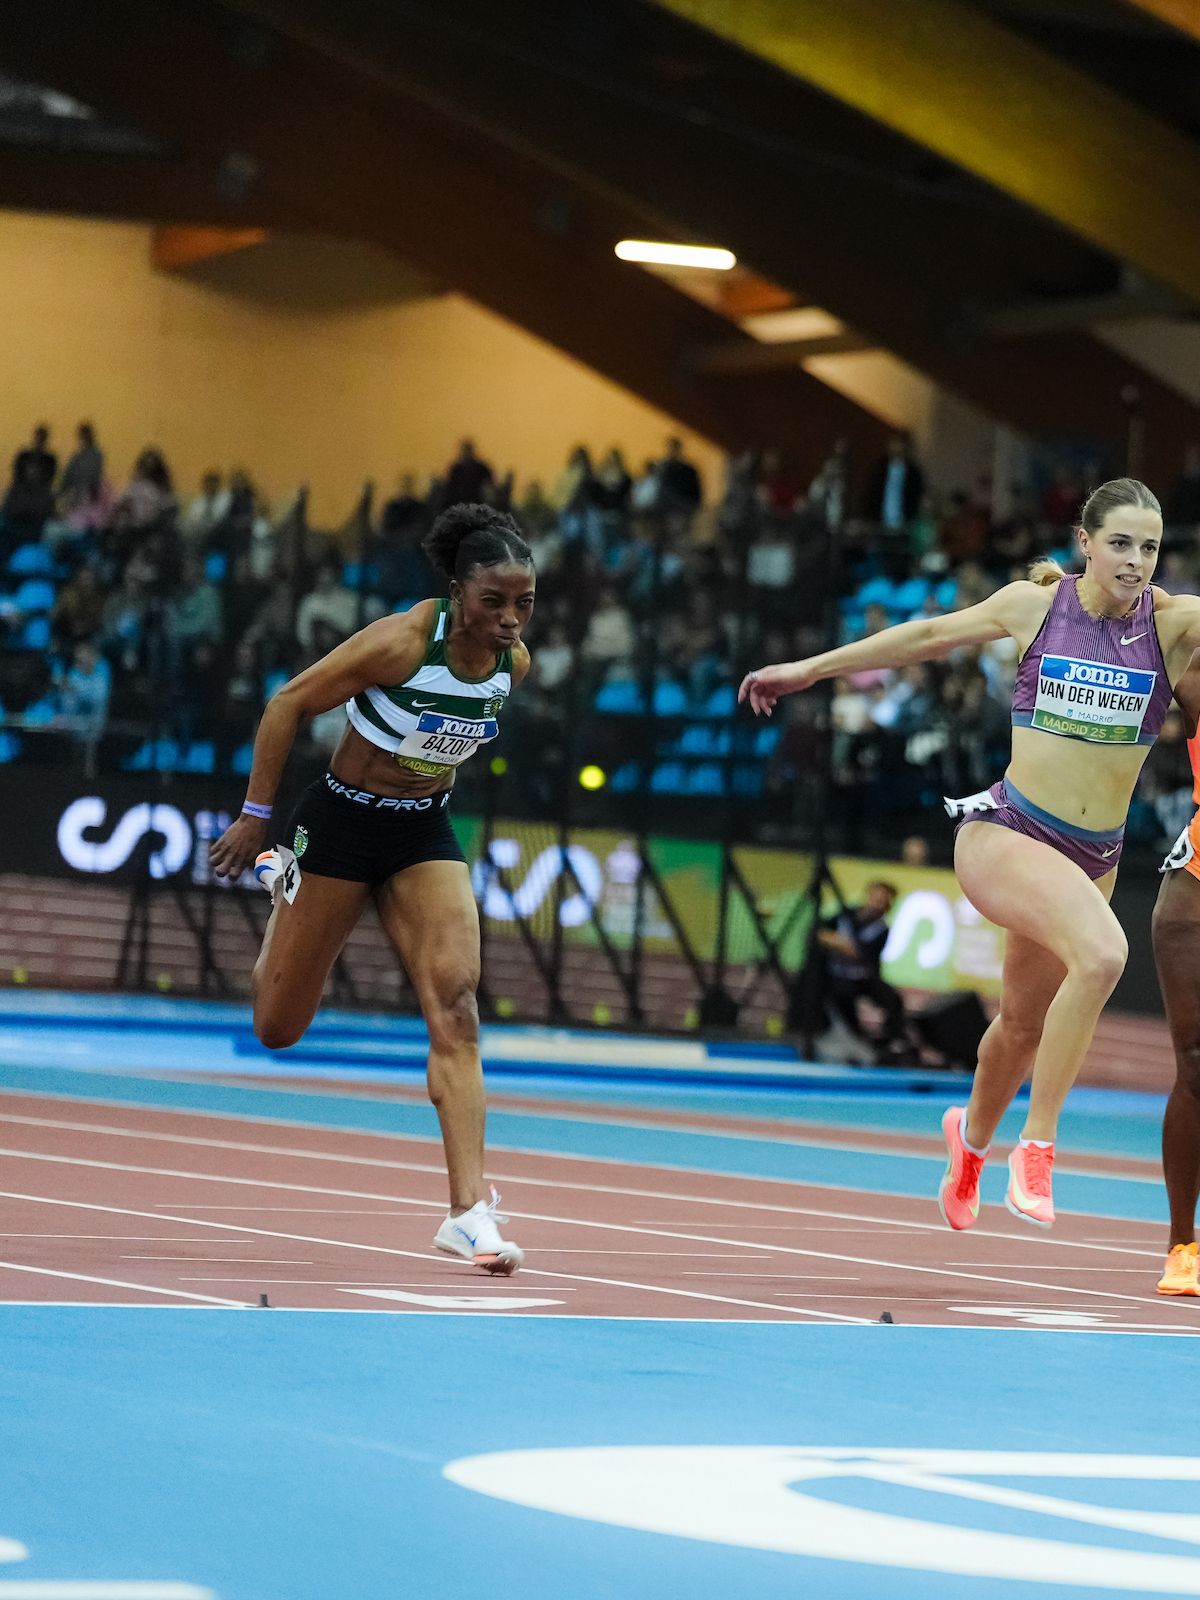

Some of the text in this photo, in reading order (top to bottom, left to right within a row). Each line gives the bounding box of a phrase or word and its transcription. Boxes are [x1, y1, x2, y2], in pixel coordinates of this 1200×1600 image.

[1040, 678, 1144, 712] VAN DER WEKEN
[1042, 715, 1107, 739] MADRID 25
[1078, 711, 1114, 724] MADRID
[375, 797, 433, 811] PRO
